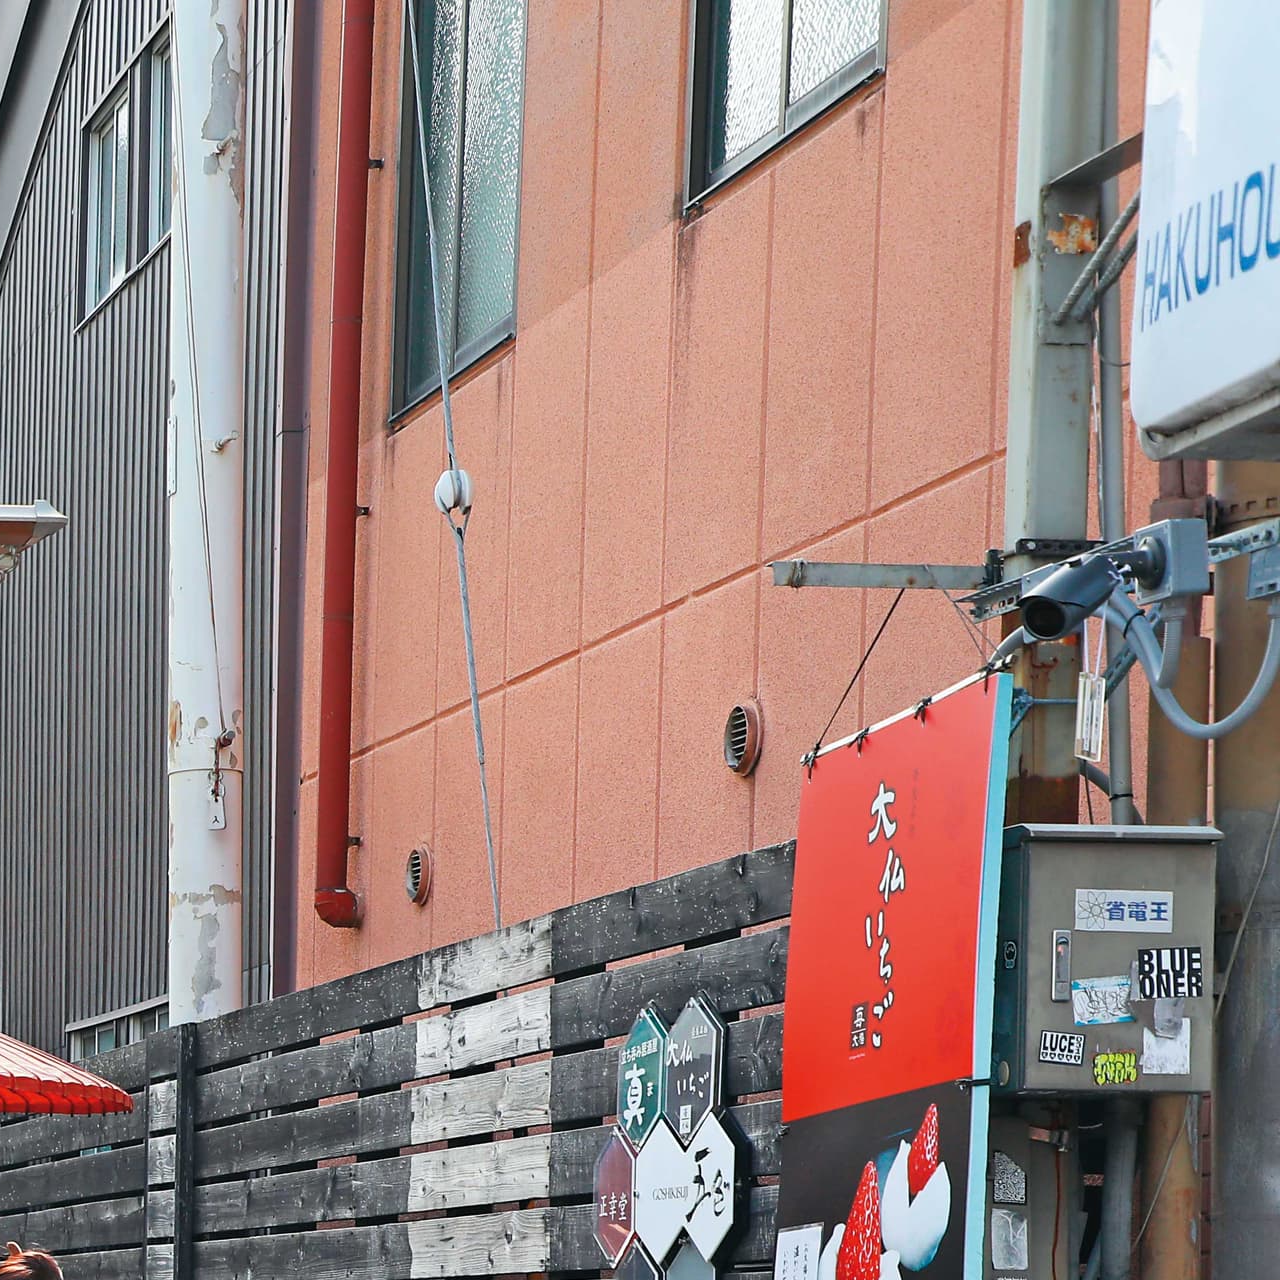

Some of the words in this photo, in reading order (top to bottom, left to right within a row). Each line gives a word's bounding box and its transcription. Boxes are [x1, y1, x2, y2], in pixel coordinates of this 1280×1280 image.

[865, 780, 906, 1048] 大仏いちご
[1106, 901, 1169, 922] 省電王
[1141, 949, 1202, 976] BLUE
[1141, 974, 1202, 999] ONER
[1043, 1032, 1075, 1054] LUCE
[623, 1063, 646, 1131] 真
[599, 1192, 628, 1221] 正幸堂
